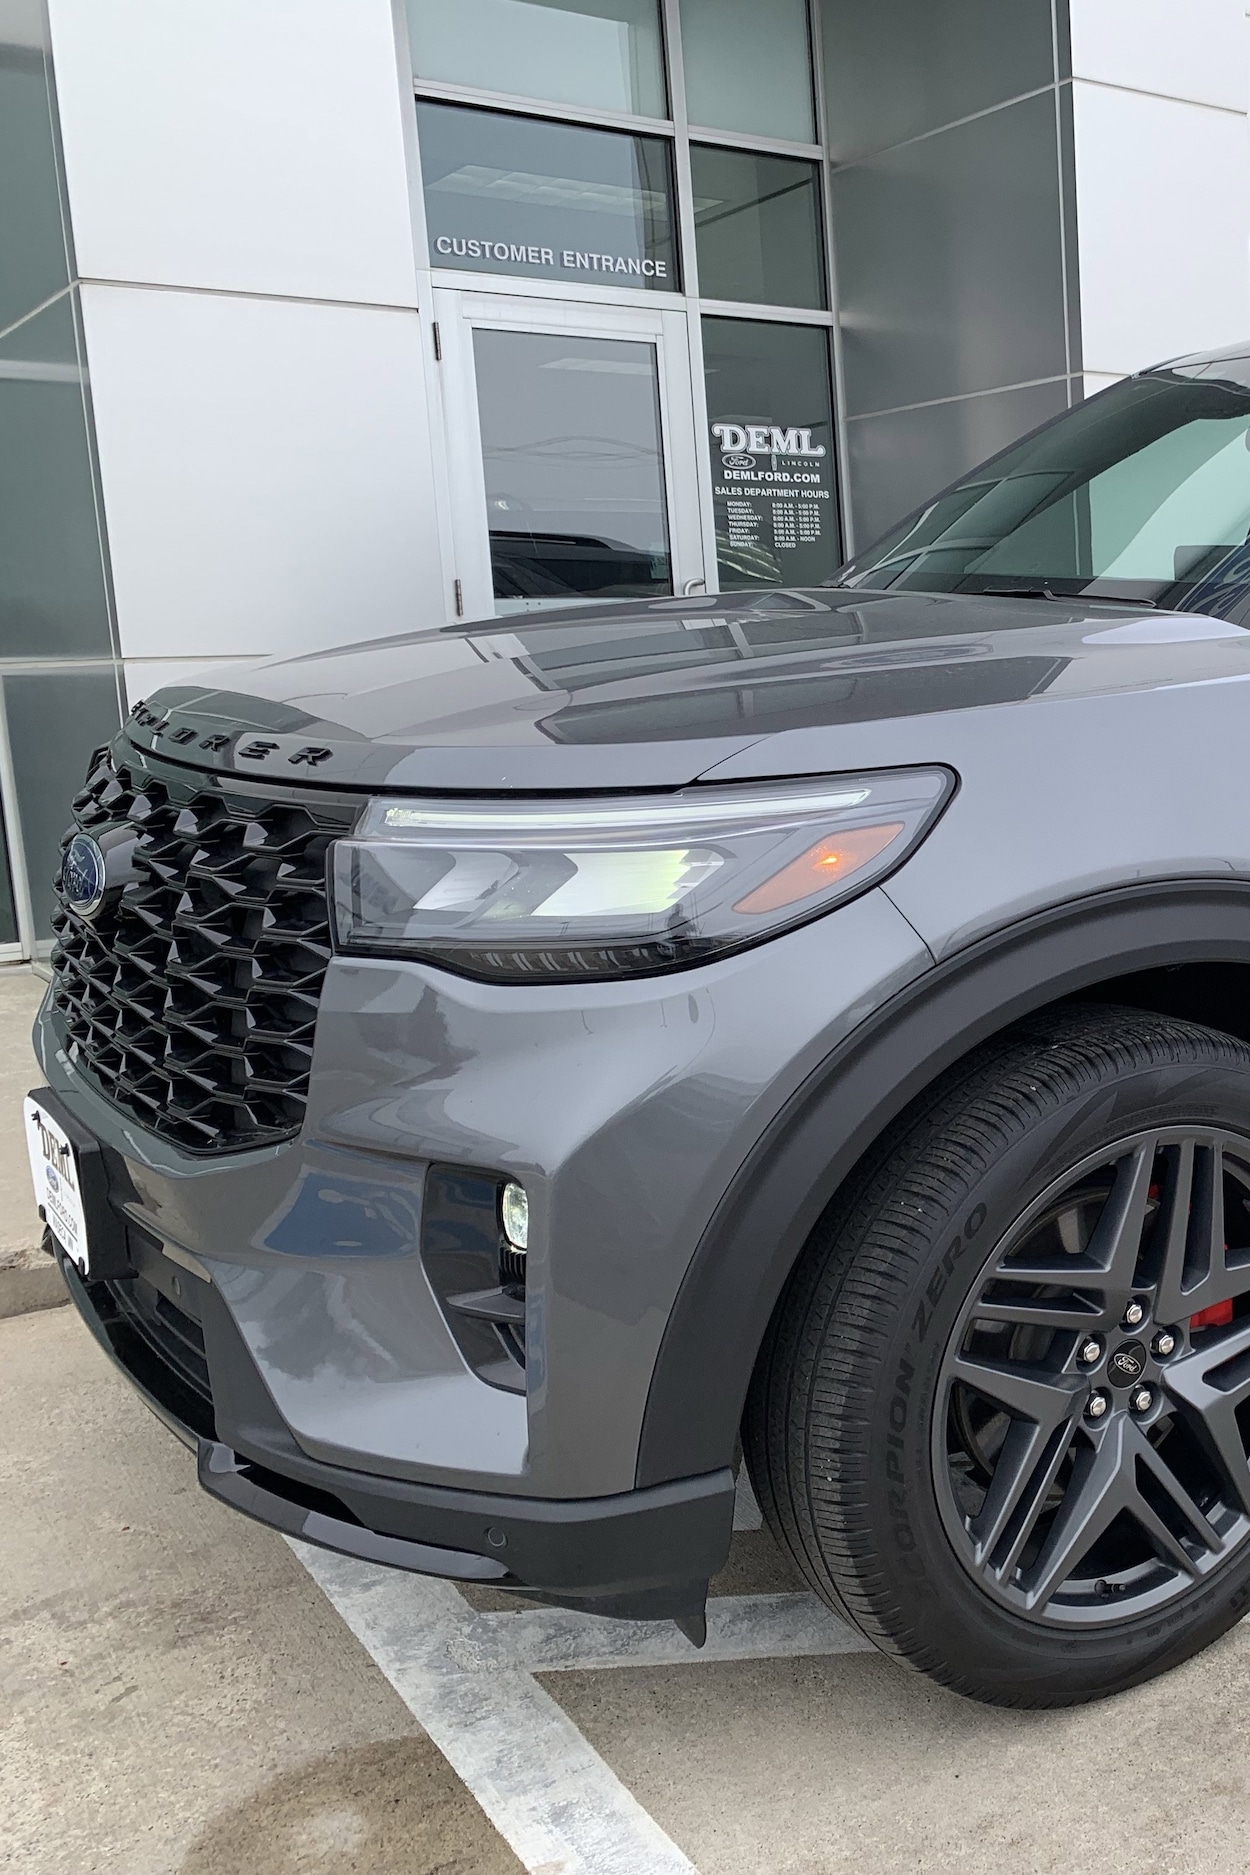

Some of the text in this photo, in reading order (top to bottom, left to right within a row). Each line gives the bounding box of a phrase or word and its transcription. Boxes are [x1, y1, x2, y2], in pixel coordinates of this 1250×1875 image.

[436, 236, 667, 278] CUSTOMER ENTRANCE
[711, 423, 826, 457] DEML
[728, 454, 749, 467] Ford
[723, 469, 821, 484] DEMLFORD.COM
[715, 486, 830, 499] SALES DEPARTMENT HOURS
[912, 1202, 988, 1338] ZERO
[1118, 1356, 1138, 1372] Ford
